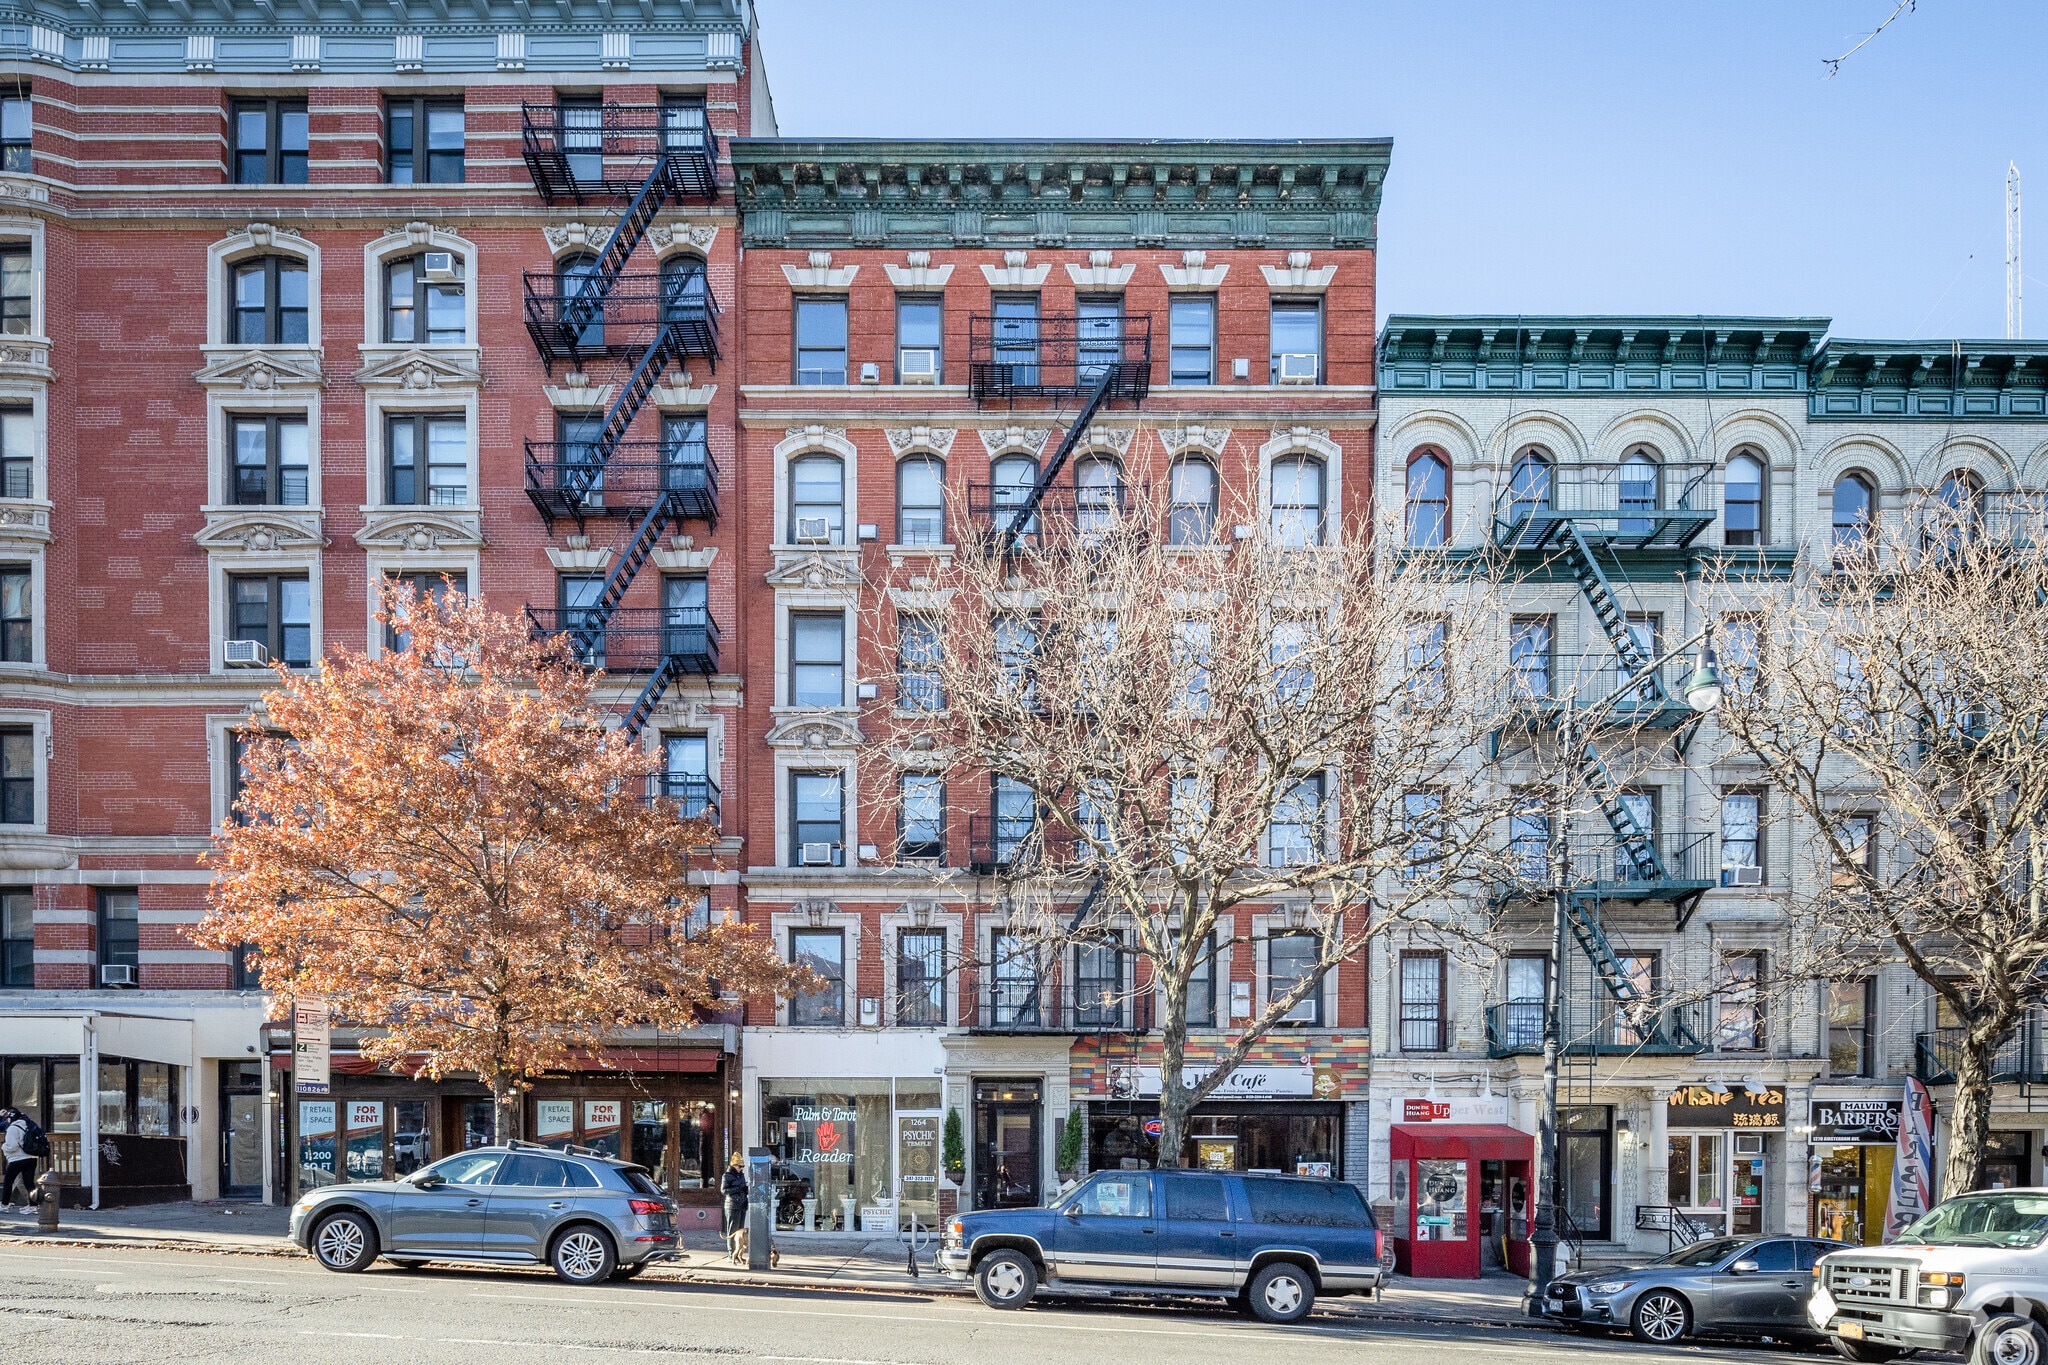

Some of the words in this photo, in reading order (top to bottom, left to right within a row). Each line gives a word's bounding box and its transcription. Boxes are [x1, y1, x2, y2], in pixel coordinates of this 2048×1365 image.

[1230, 1073, 1267, 1089] Café
[309, 1106, 333, 1114] RETAIL
[356, 1105, 376, 1114] FOR
[547, 1105, 571, 1113] RETAIL
[593, 1105, 613, 1113] FOR
[795, 1107, 820, 1121] Palm
[821, 1106, 832, 1121] &
[833, 1107, 857, 1121] Tarot
[1472, 1104, 1504, 1115] West
[309, 1116, 333, 1124] SPACE
[354, 1114, 379, 1123] RENT
[548, 1115, 571, 1123] SPACE
[591, 1114, 617, 1122] RENT
[1144, 1123, 1161, 1132] OPE
[902, 1130, 936, 1140] PSYCHIC
[798, 1148, 854, 1163] Reader
[303, 1162, 318, 1171] SQ
[321, 1162, 332, 1171] FT
[862, 1208, 893, 1216] PSYCHIC
